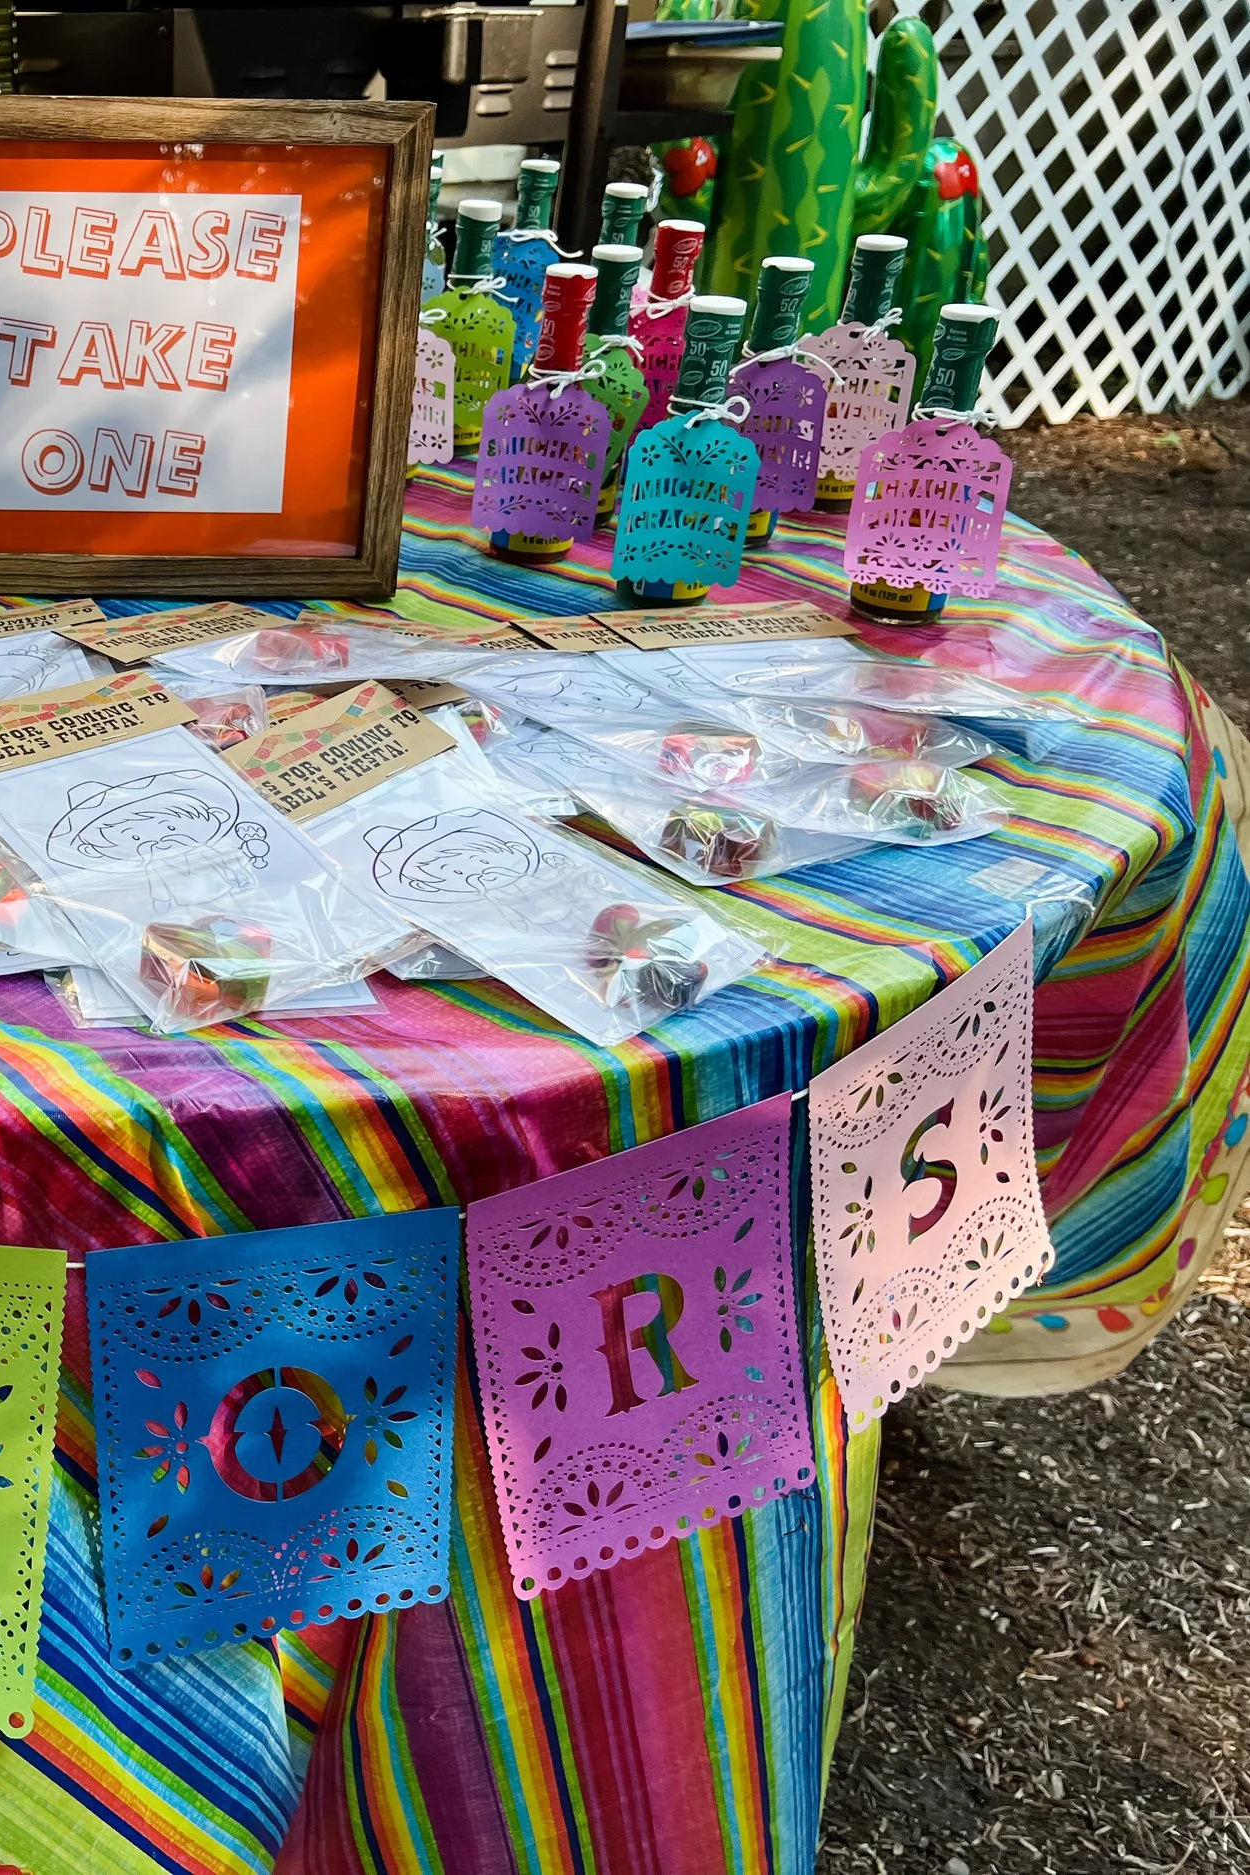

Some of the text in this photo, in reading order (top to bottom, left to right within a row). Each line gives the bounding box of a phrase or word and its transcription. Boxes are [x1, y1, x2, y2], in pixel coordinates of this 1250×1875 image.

[673, 256, 689, 269] 50
[780, 298, 798, 312] 50
[690, 341, 707, 356] 50
[710, 360, 728, 376] 50
[936, 367, 956, 386] 50
[21, 428, 206, 498] ONE
[636, 477, 737, 511] MUCHAS
[632, 509, 733, 542] GRACIAS
[68, 607, 94, 616] TO
[623, 612, 834, 635] THANKS FOR COMING TO
[95, 630, 158, 648] THANKS
[159, 625, 190, 638] FOR
[188, 613, 246, 634] COMING
[47, 701, 136, 732] COMING
[138, 691, 170, 707] TO
[54, 713, 145, 745] FIESTA!
[277, 760, 322, 788] FOR
[318, 722, 393, 766] COMING
[389, 708, 421, 729] TO
[271, 739, 410, 816] ABEL'S FIESTA!
[196, 1365, 351, 1504] O
[592, 1272, 698, 1419] R
[899, 1096, 959, 1245] S
